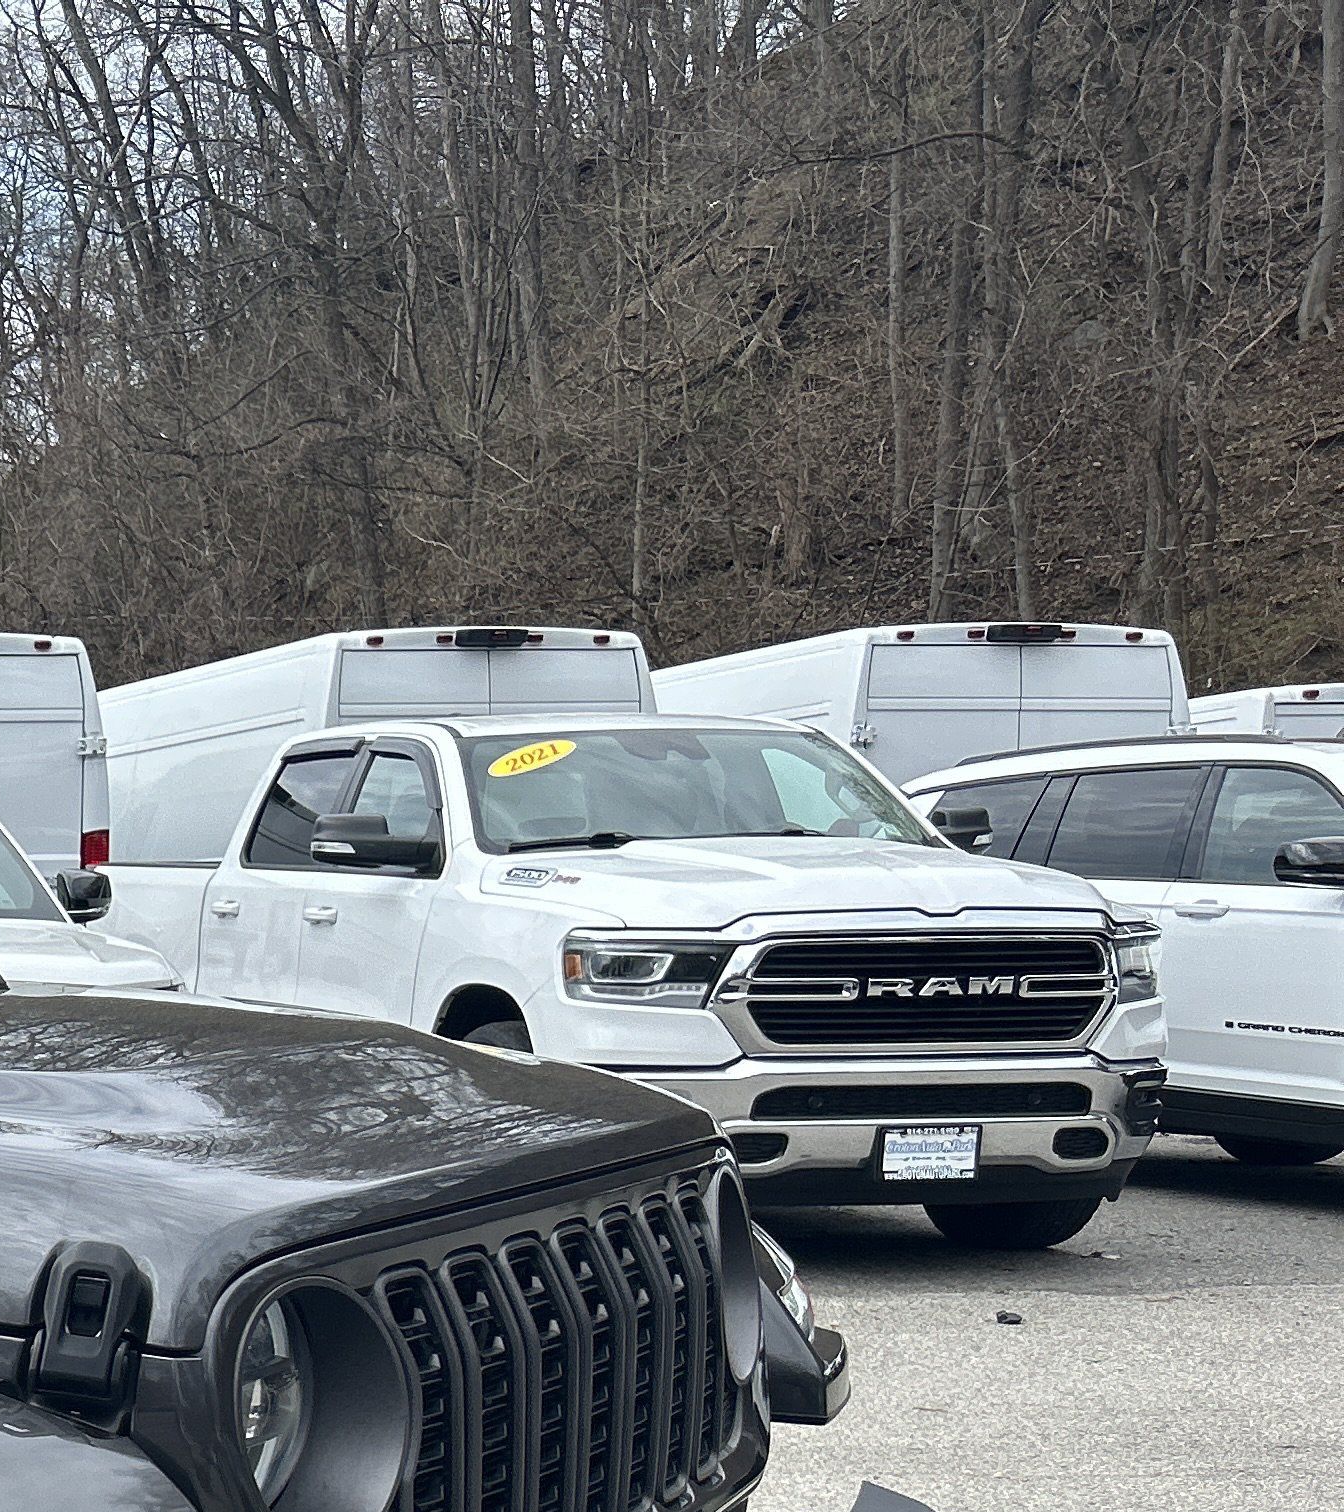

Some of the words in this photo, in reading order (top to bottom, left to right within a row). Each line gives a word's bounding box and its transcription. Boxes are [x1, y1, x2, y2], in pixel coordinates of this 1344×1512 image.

[506, 744, 560, 772] 2021
[867, 976, 1015, 998] RAM
[1237, 1022, 1285, 1032] GRAND
